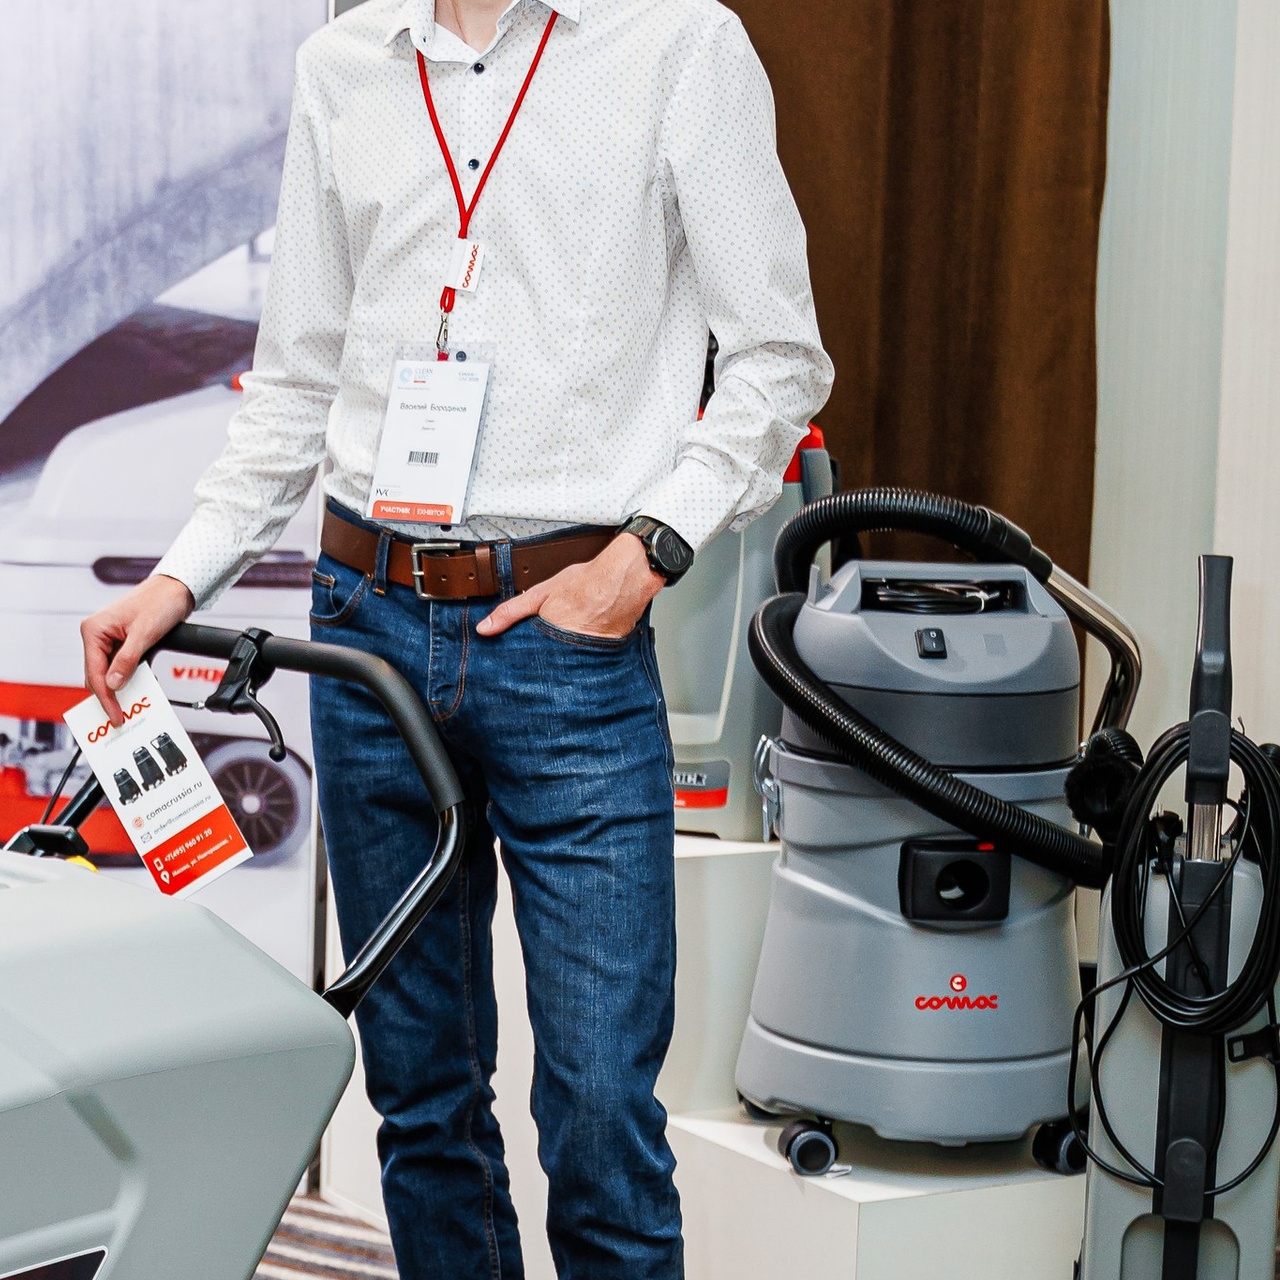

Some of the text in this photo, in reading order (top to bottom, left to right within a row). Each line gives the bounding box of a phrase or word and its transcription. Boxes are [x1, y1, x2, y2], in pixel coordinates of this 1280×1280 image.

[462, 244, 479, 288] comac
[380, 506, 446, 517] УЧАСТНИК EXHIBITOR
[146, 780, 203, 821] comacrussia.ru
[204, 828, 213, 838] 20
[915, 994, 998, 1010] comac
